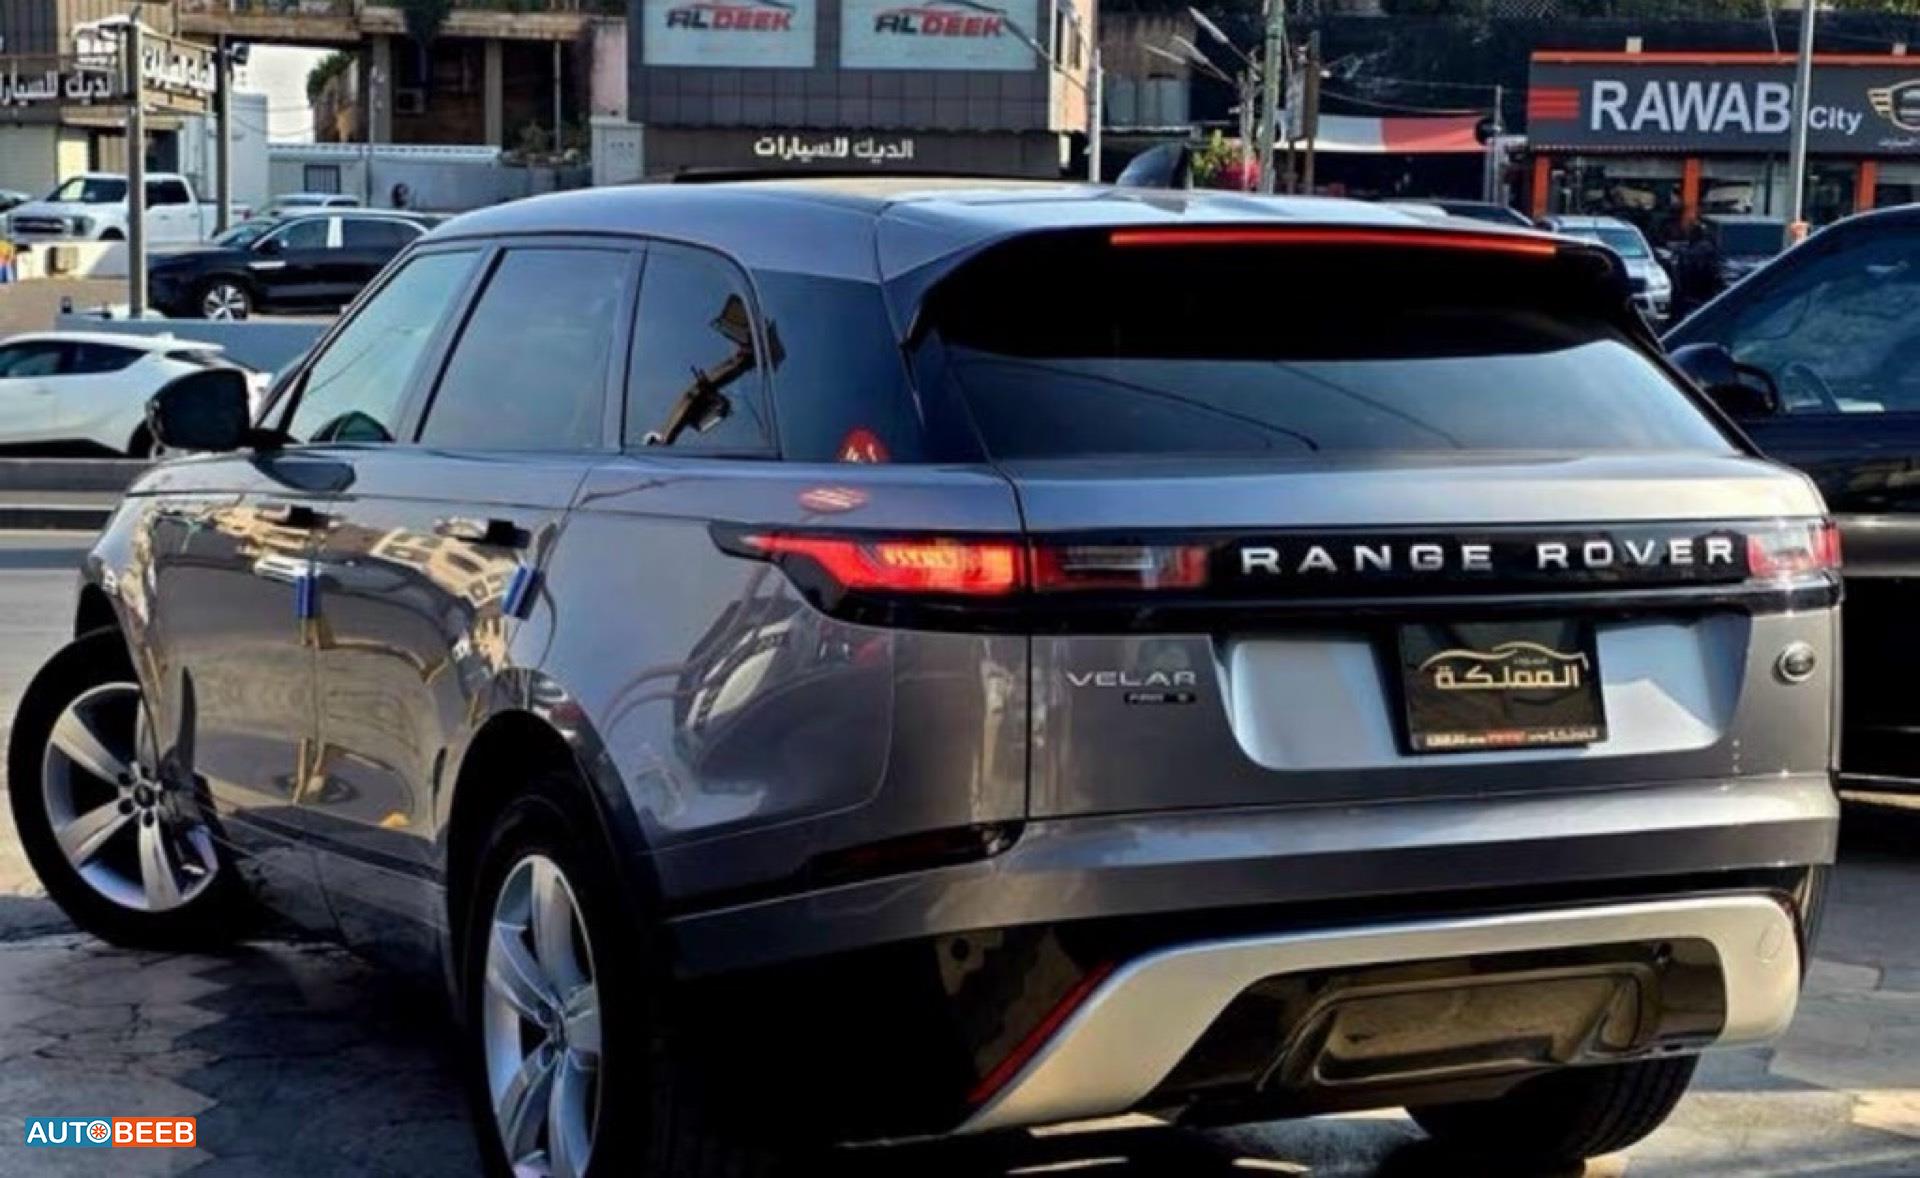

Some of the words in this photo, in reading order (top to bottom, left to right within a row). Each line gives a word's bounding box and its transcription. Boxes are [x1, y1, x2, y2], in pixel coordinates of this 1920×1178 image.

[1591, 80, 1797, 133] RAWAB
[754, 134, 848, 163] للسيارات
[853, 137, 914, 164] الديك
[1240, 545, 1492, 574] RANGE
[1537, 537, 1733, 569] ROVER
[1066, 671, 1196, 687] VELAR
[1435, 664, 1579, 690] المملكة
